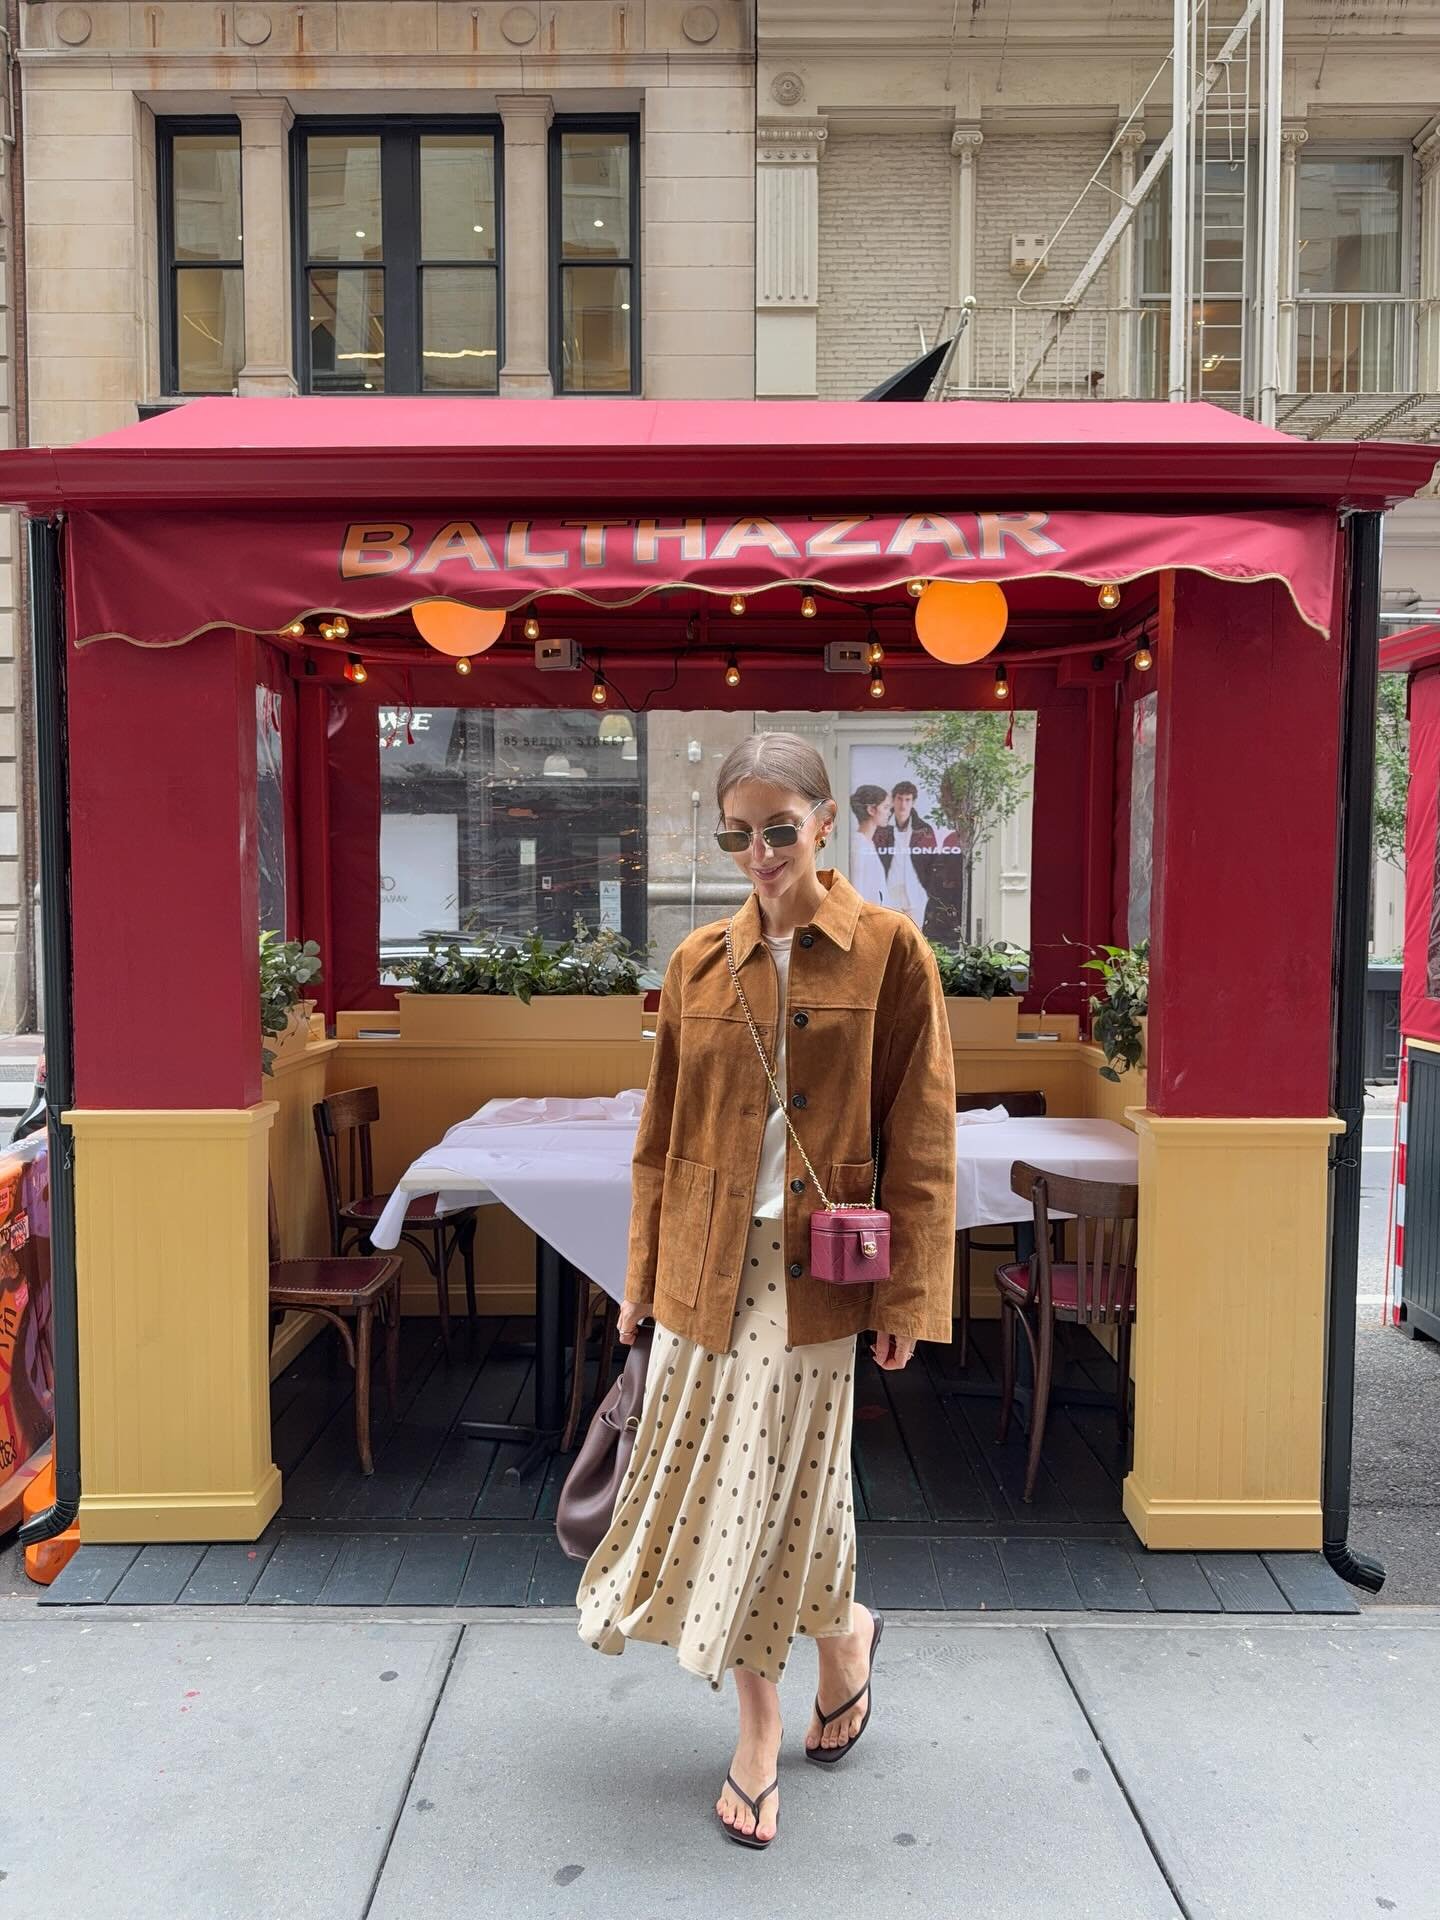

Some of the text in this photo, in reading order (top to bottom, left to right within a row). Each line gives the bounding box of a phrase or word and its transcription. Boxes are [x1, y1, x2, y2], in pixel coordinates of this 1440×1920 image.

[340, 510, 1066, 581] BALTHAZAR
[503, 735, 626, 747] 85 SPRING STREET
